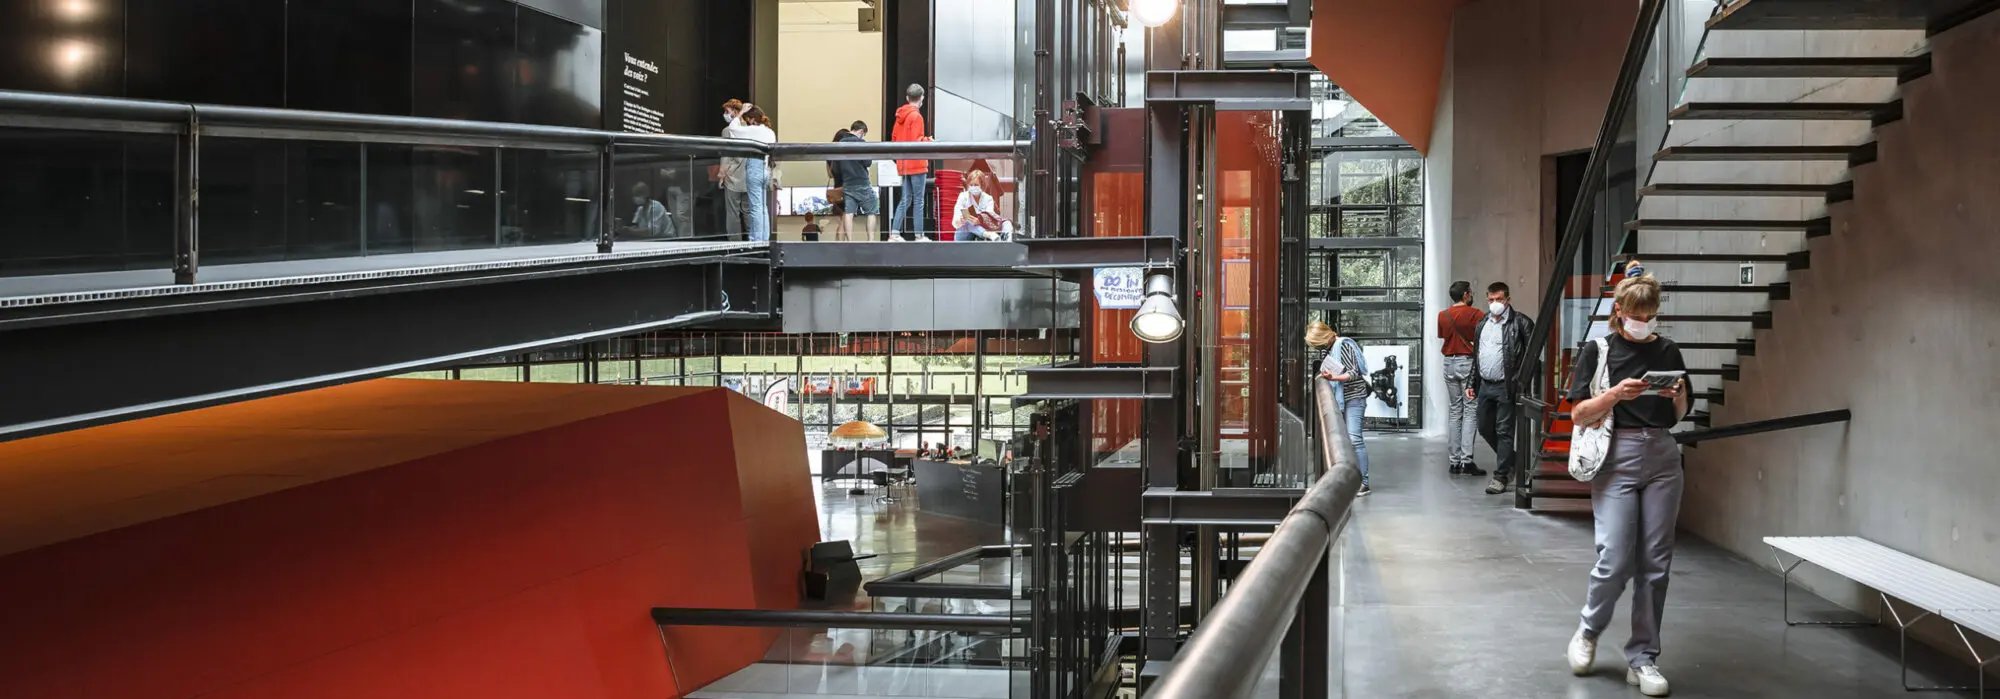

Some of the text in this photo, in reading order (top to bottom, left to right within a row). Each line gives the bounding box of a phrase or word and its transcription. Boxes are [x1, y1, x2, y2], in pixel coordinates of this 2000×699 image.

[624, 52, 636, 65] Vous
[624, 65, 633, 77] des
[633, 71, 644, 82] voix
